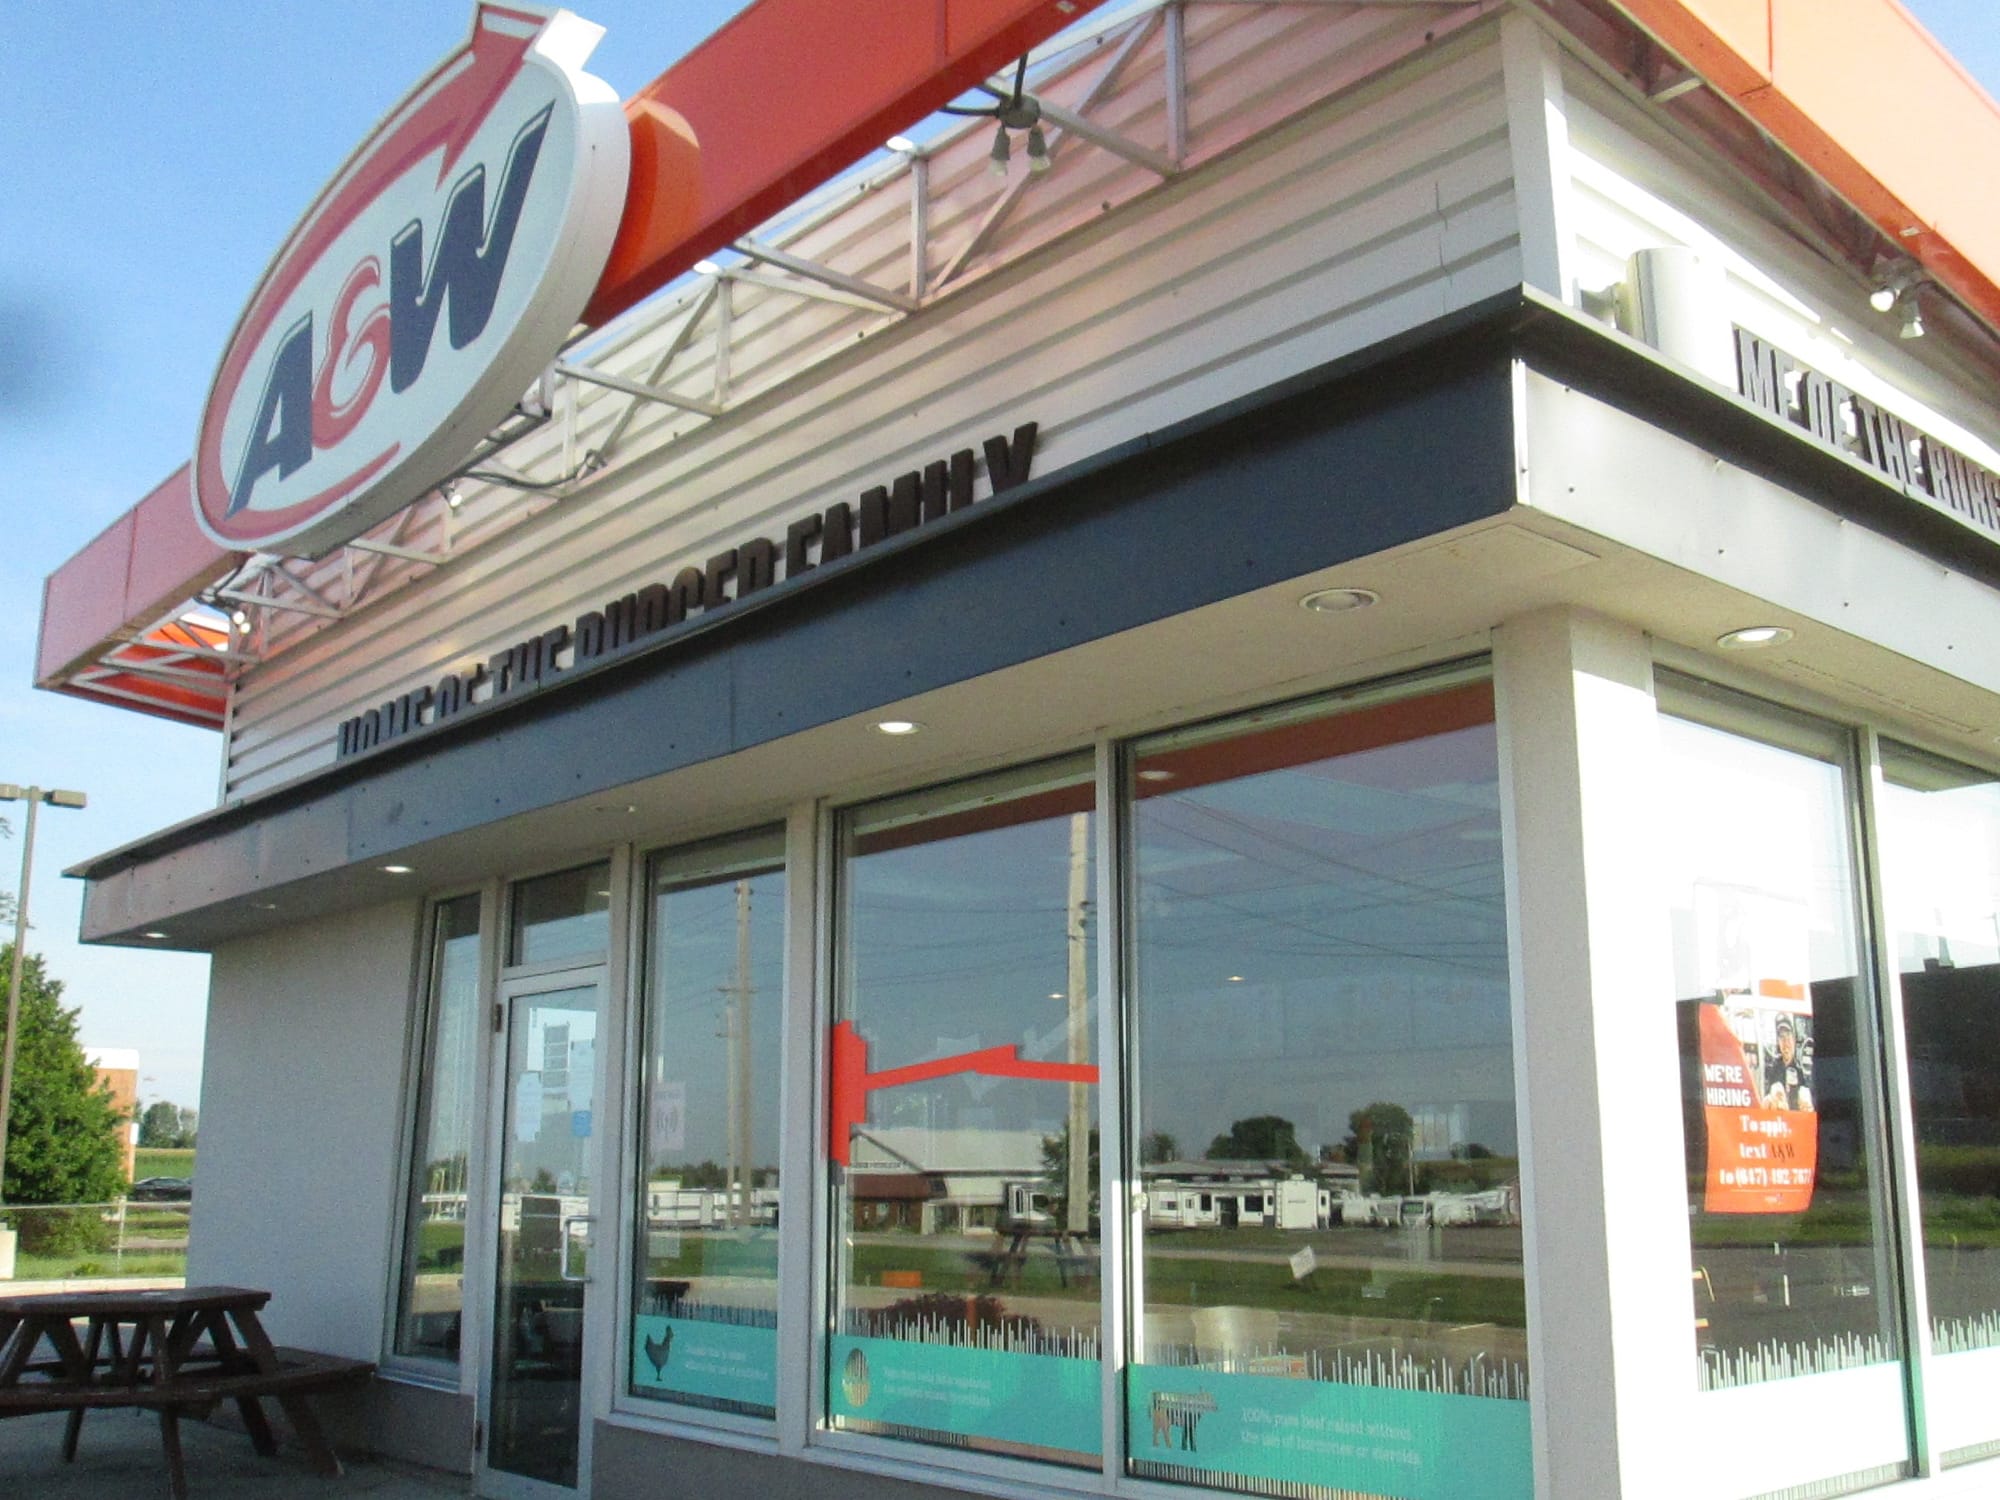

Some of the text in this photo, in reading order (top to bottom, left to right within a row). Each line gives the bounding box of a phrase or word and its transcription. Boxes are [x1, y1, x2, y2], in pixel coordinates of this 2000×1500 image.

[224, 98, 556, 520] A&W
[1704, 1063, 1743, 1083] WE'RE
[1706, 1087, 1751, 1106] HIRING
[1739, 1114, 1758, 1133] To
[1720, 1168, 1734, 1185] to
